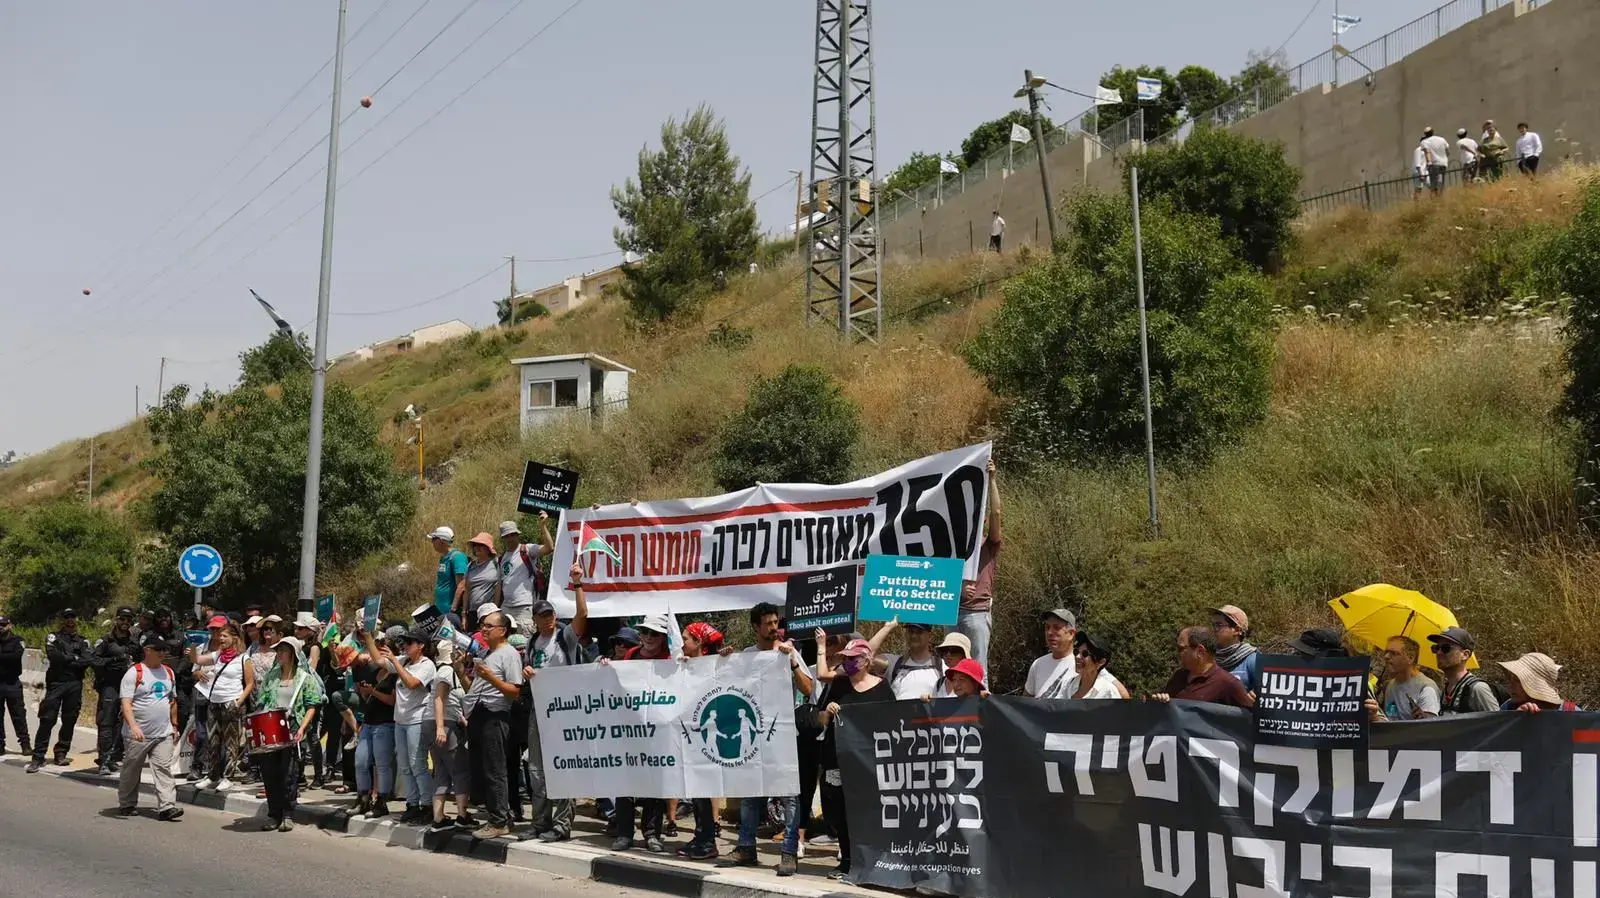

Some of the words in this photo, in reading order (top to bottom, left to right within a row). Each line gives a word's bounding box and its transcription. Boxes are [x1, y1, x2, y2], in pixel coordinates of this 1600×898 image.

[549, 492, 560, 500] לא
[876, 464, 984, 562] 150
[776, 512, 874, 568] מאחזים
[640, 529, 702, 576] חומש
[841, 583, 847, 596] لا
[878, 576, 928, 589] Putting
[930, 580, 946, 588] an
[813, 586, 839, 604] تسرق
[870, 587, 893, 596] end
[895, 589, 908, 598] to
[910, 590, 954, 600] Settler
[794, 604, 820, 616] תגנוב!
[822, 600, 835, 612] לא
[882, 599, 935, 611] Violence
[834, 614, 851, 623] steal
[1261, 672, 1362, 698] הכיבוש!
[546, 695, 582, 718] السلام
[585, 690, 605, 714] أجل
[608, 694, 624, 710] من
[625, 690, 676, 711] مقاتلون
[1260, 697, 1283, 709] לנו?
[1286, 698, 1319, 712] עולה
[1322, 702, 1336, 712] זה
[1336, 701, 1360, 712] כמה
[563, 724, 606, 741] לשלום
[611, 722, 656, 738] לוחמים
[1260, 719, 1289, 730] בעיניים
[1292, 720, 1325, 731] לכיבוש
[873, 719, 982, 758] מסתכלים
[553, 754, 623, 770] Combatants
[626, 752, 638, 766] for
[640, 752, 676, 768] Peace
[701, 747, 734, 768] Combatants
[744, 746, 759, 763] Peace
[876, 757, 984, 790] לכיבוש
[1044, 732, 1522, 826] דמוקרטיה
[880, 792, 983, 838] בעיניים
[875, 860, 903, 871] Straight
[962, 867, 981, 876] eyes
[1138, 822, 1393, 898] כיבוש
